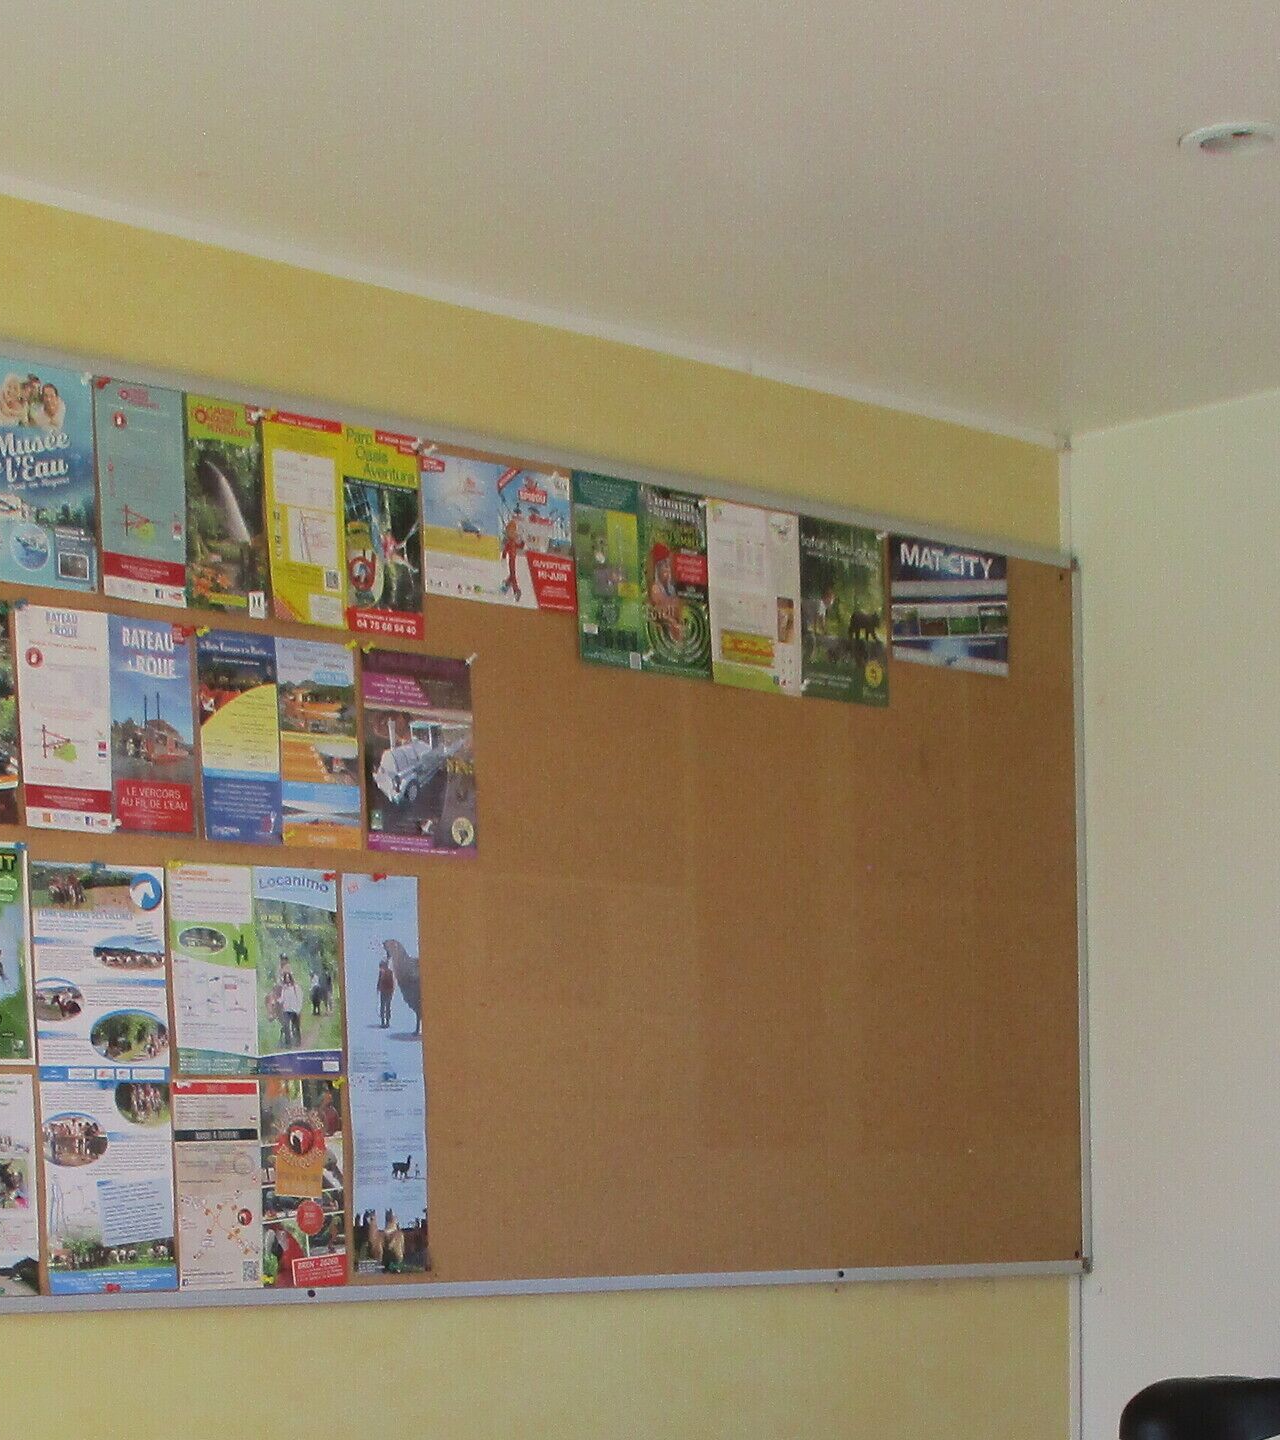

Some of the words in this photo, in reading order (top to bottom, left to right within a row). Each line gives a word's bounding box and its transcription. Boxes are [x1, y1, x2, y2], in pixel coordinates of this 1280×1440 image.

[122, 625, 175, 654] BATEAU
[138, 787, 182, 800] VERCORS
[121, 796, 134, 807] AU
[149, 799, 161, 810] DE
